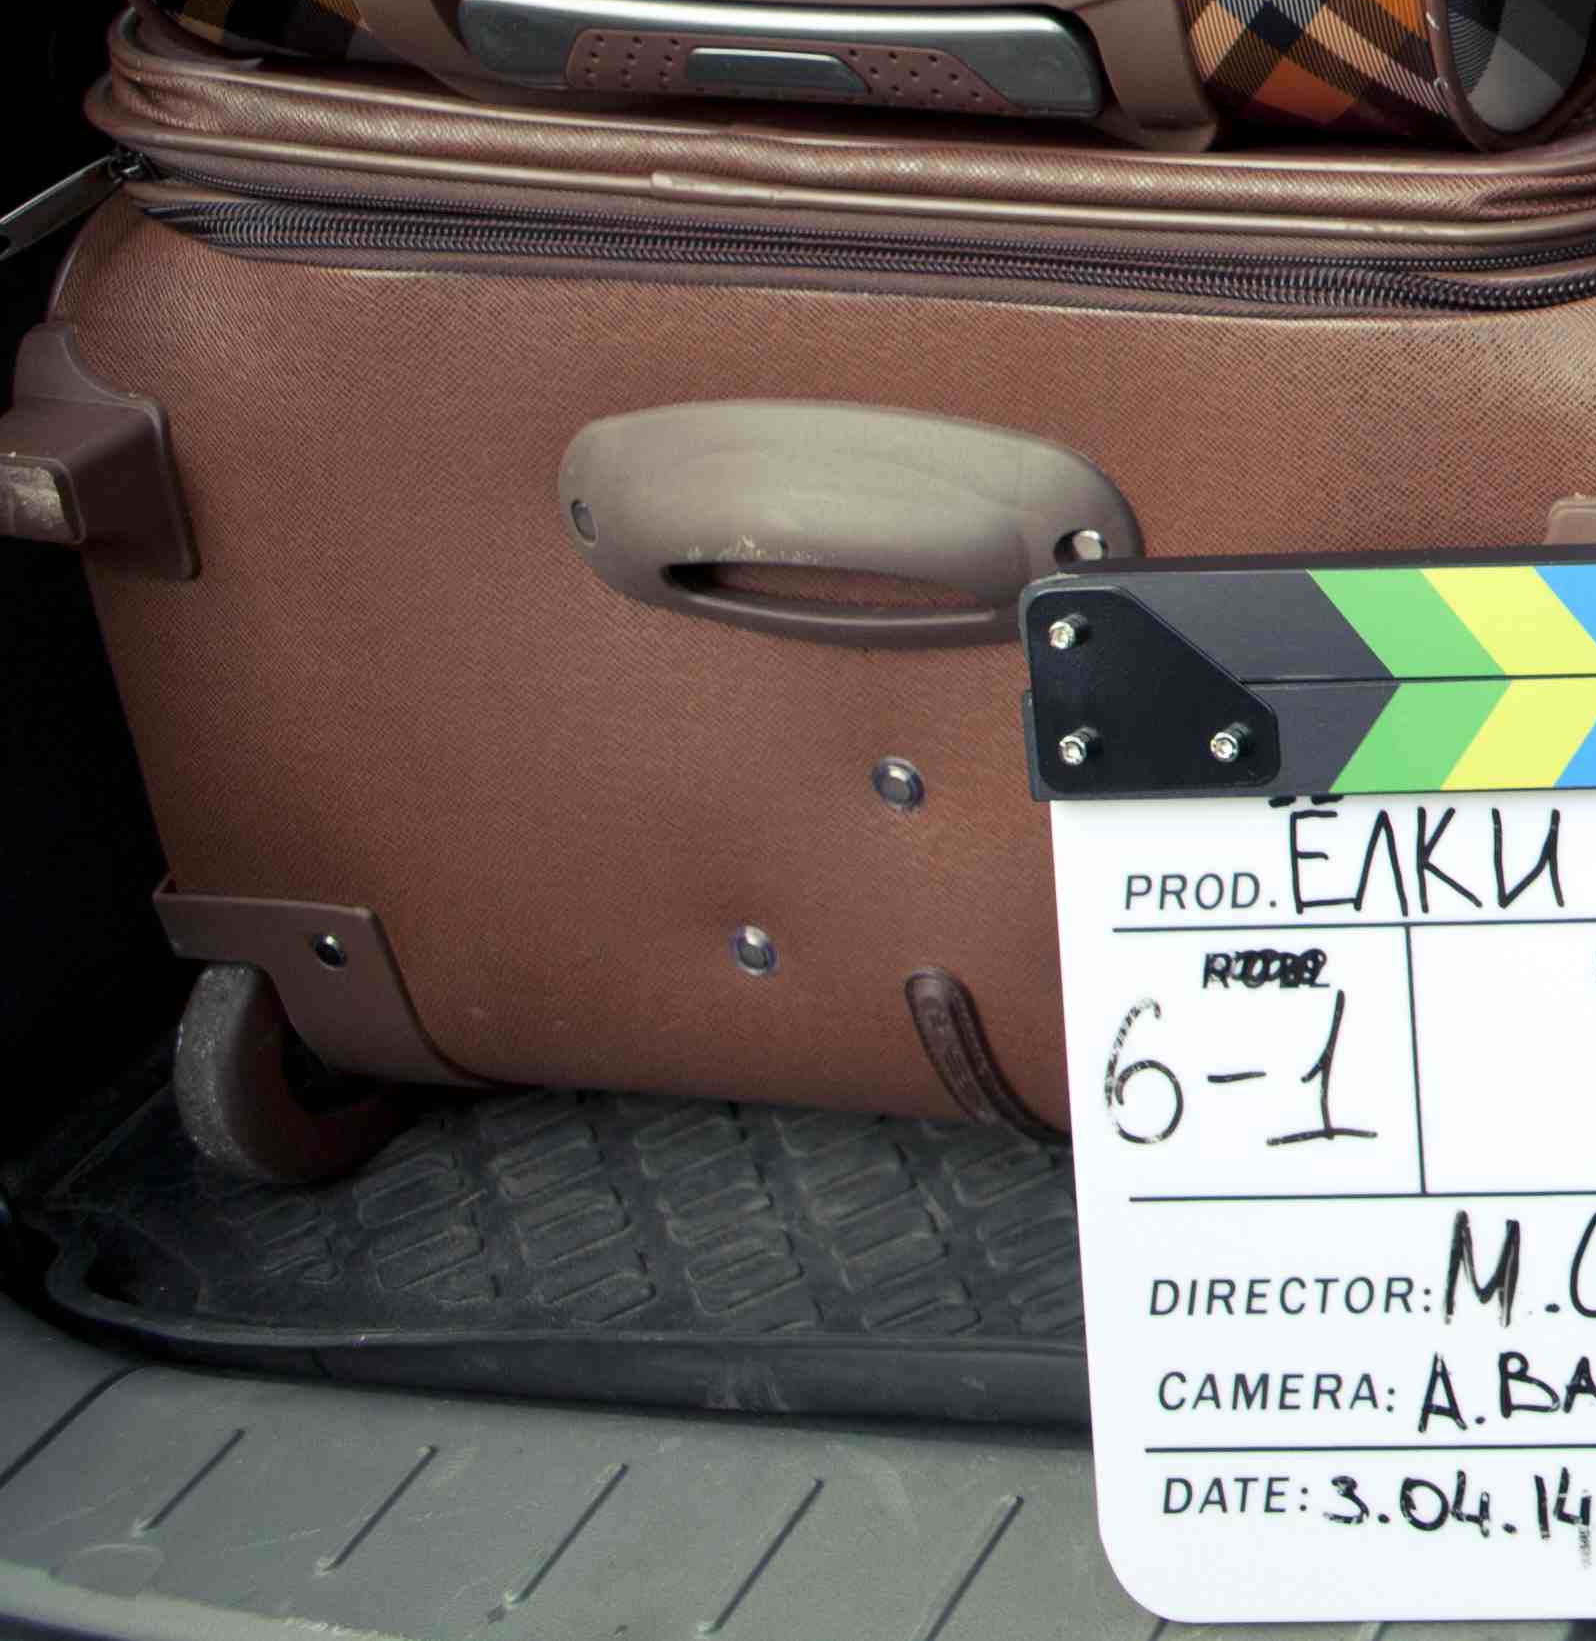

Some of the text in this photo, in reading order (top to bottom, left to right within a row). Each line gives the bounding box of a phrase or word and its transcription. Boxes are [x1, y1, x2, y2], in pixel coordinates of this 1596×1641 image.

[1269, 793, 1565, 916] ЁЛКИ
[1125, 872, 1278, 911] PROD.
[1105, 989, 1377, 1146] 6-1
[1149, 1276, 1433, 1317] DIRECTOR:
[1158, 1370, 1397, 1413] CAMERA:
[1163, 1476, 1309, 1515] DATE:
[1323, 1465, 1593, 1564] 3.04.14
